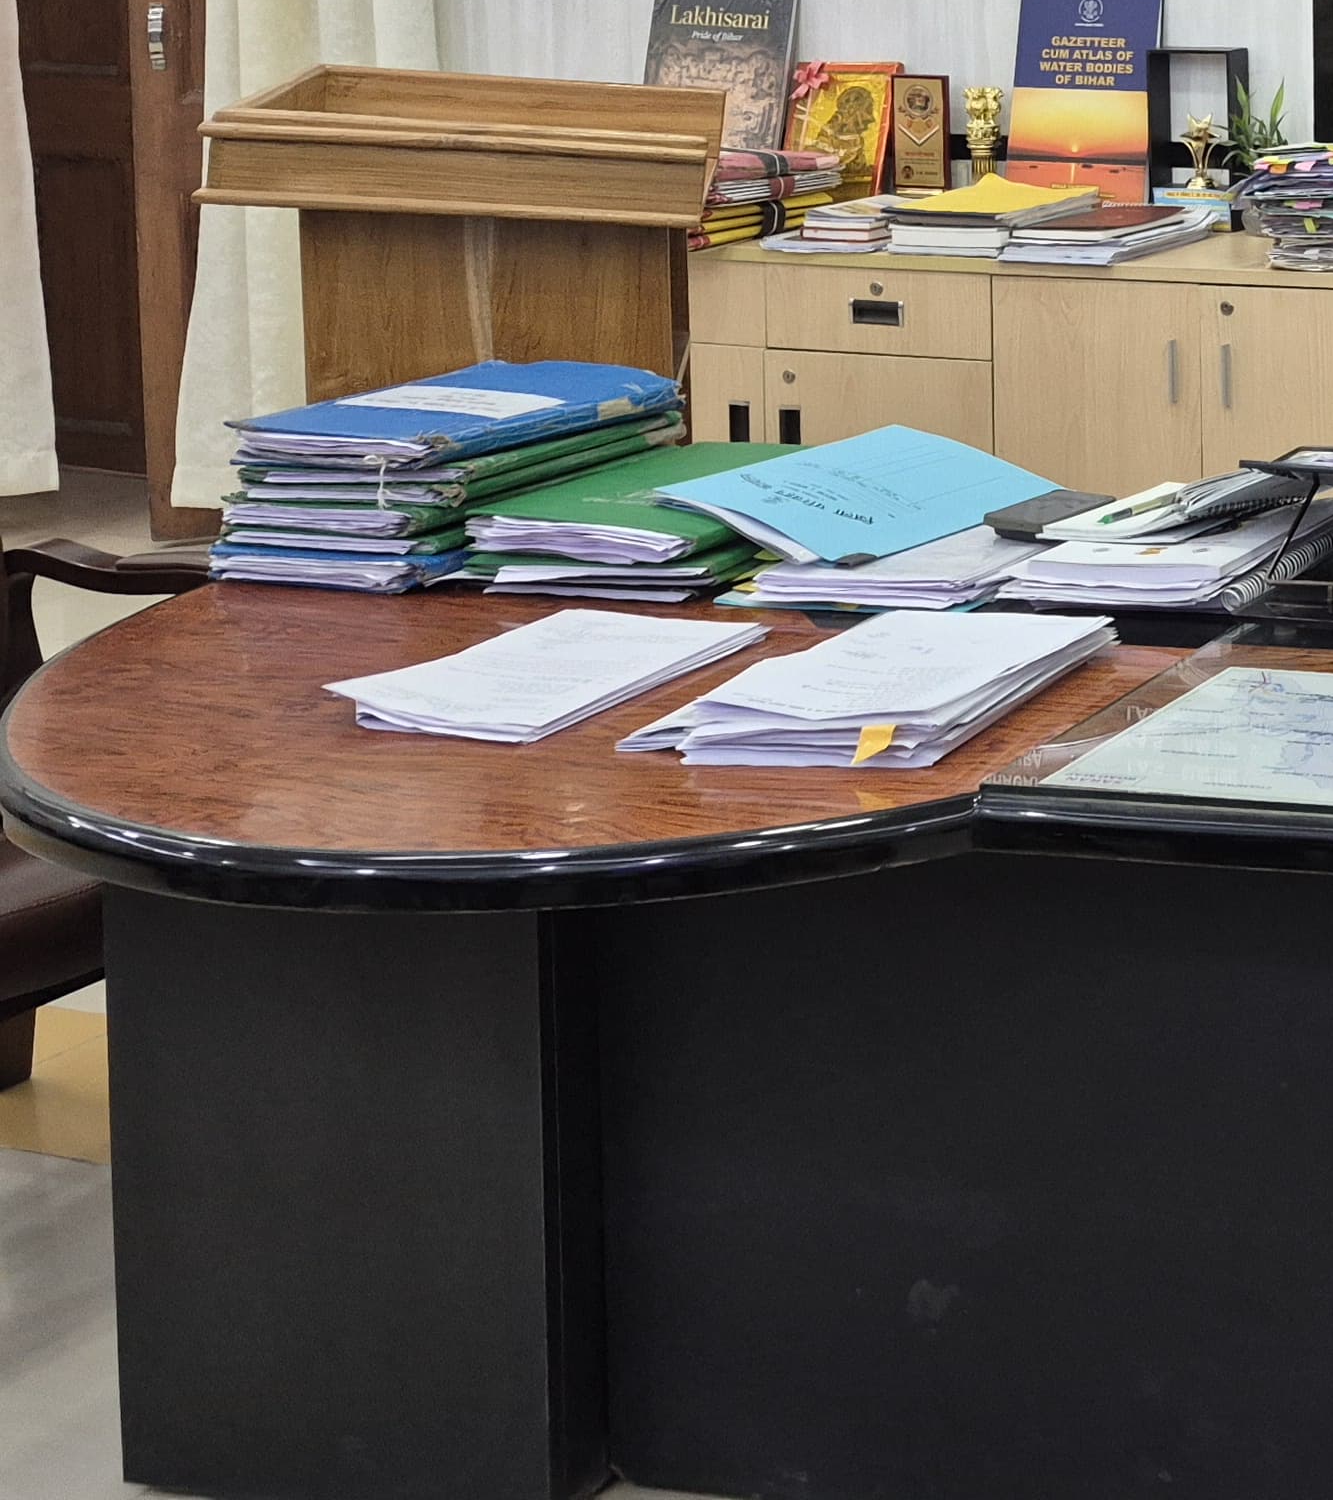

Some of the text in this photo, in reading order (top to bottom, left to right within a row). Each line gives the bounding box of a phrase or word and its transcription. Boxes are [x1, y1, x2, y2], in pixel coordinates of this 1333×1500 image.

[670, 4, 770, 29] Lakhisarai
[1051, 36, 1126, 48] GAZETTEER
[1042, 49, 1134, 61] CUM ATLAS OF
[1040, 61, 1134, 74] WATER BODIES
[1055, 74, 1115, 86] OF BIHAR
